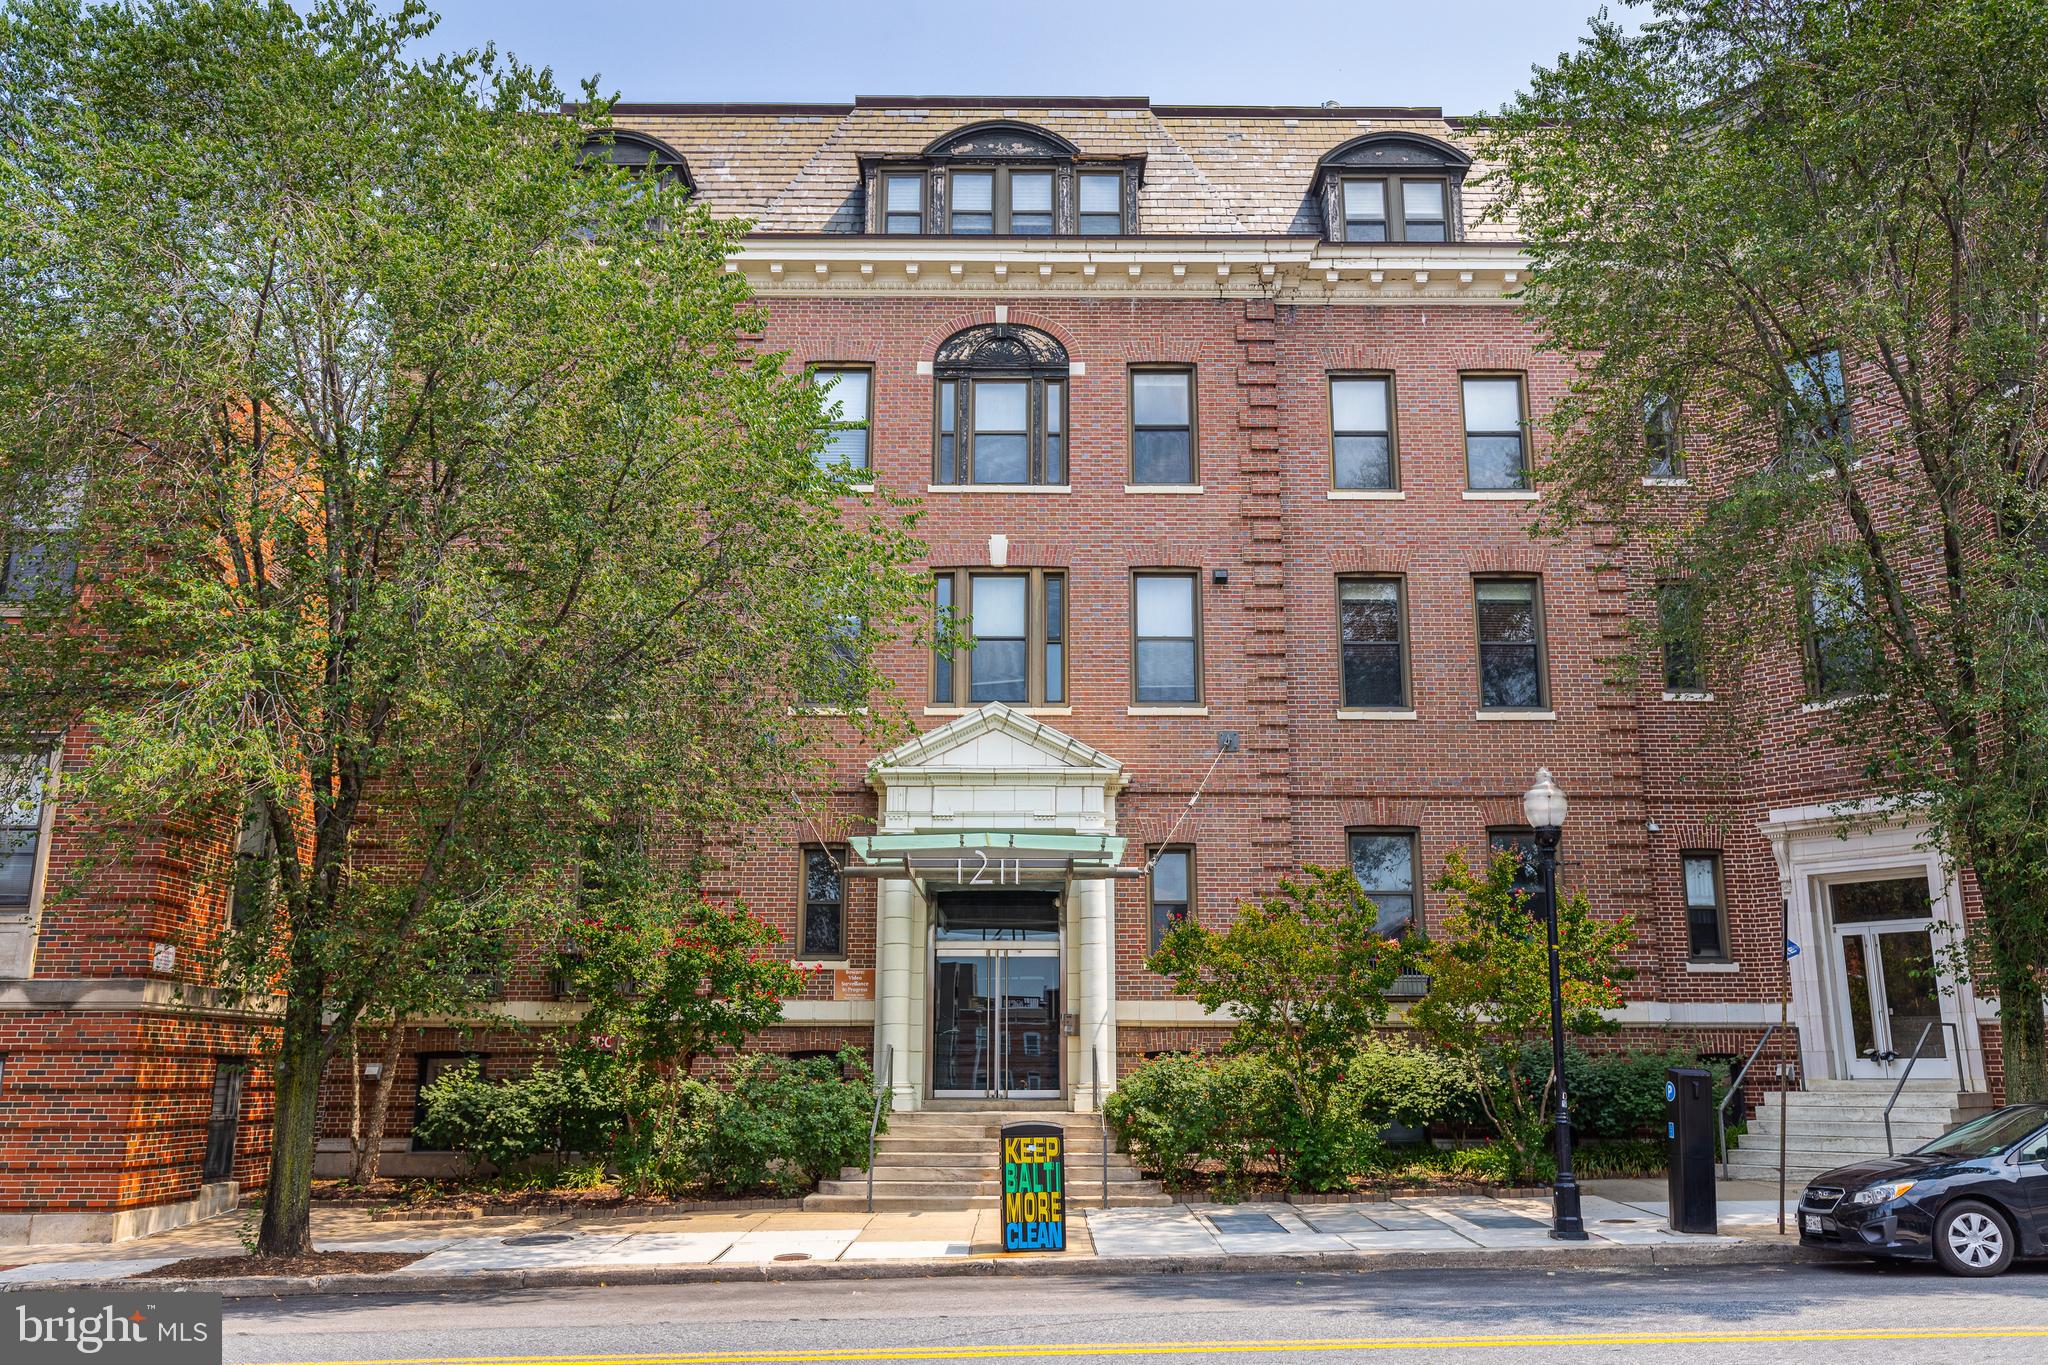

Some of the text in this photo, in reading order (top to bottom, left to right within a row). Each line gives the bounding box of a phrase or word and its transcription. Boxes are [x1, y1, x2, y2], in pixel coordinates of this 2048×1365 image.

[957, 849, 1020, 885] 1211
[1005, 1137, 1060, 1163] KEEP
[1005, 1162, 1061, 1193] BALTI
[1006, 1192, 1062, 1222] MORE
[1006, 1222, 1063, 1249] CLEAN
